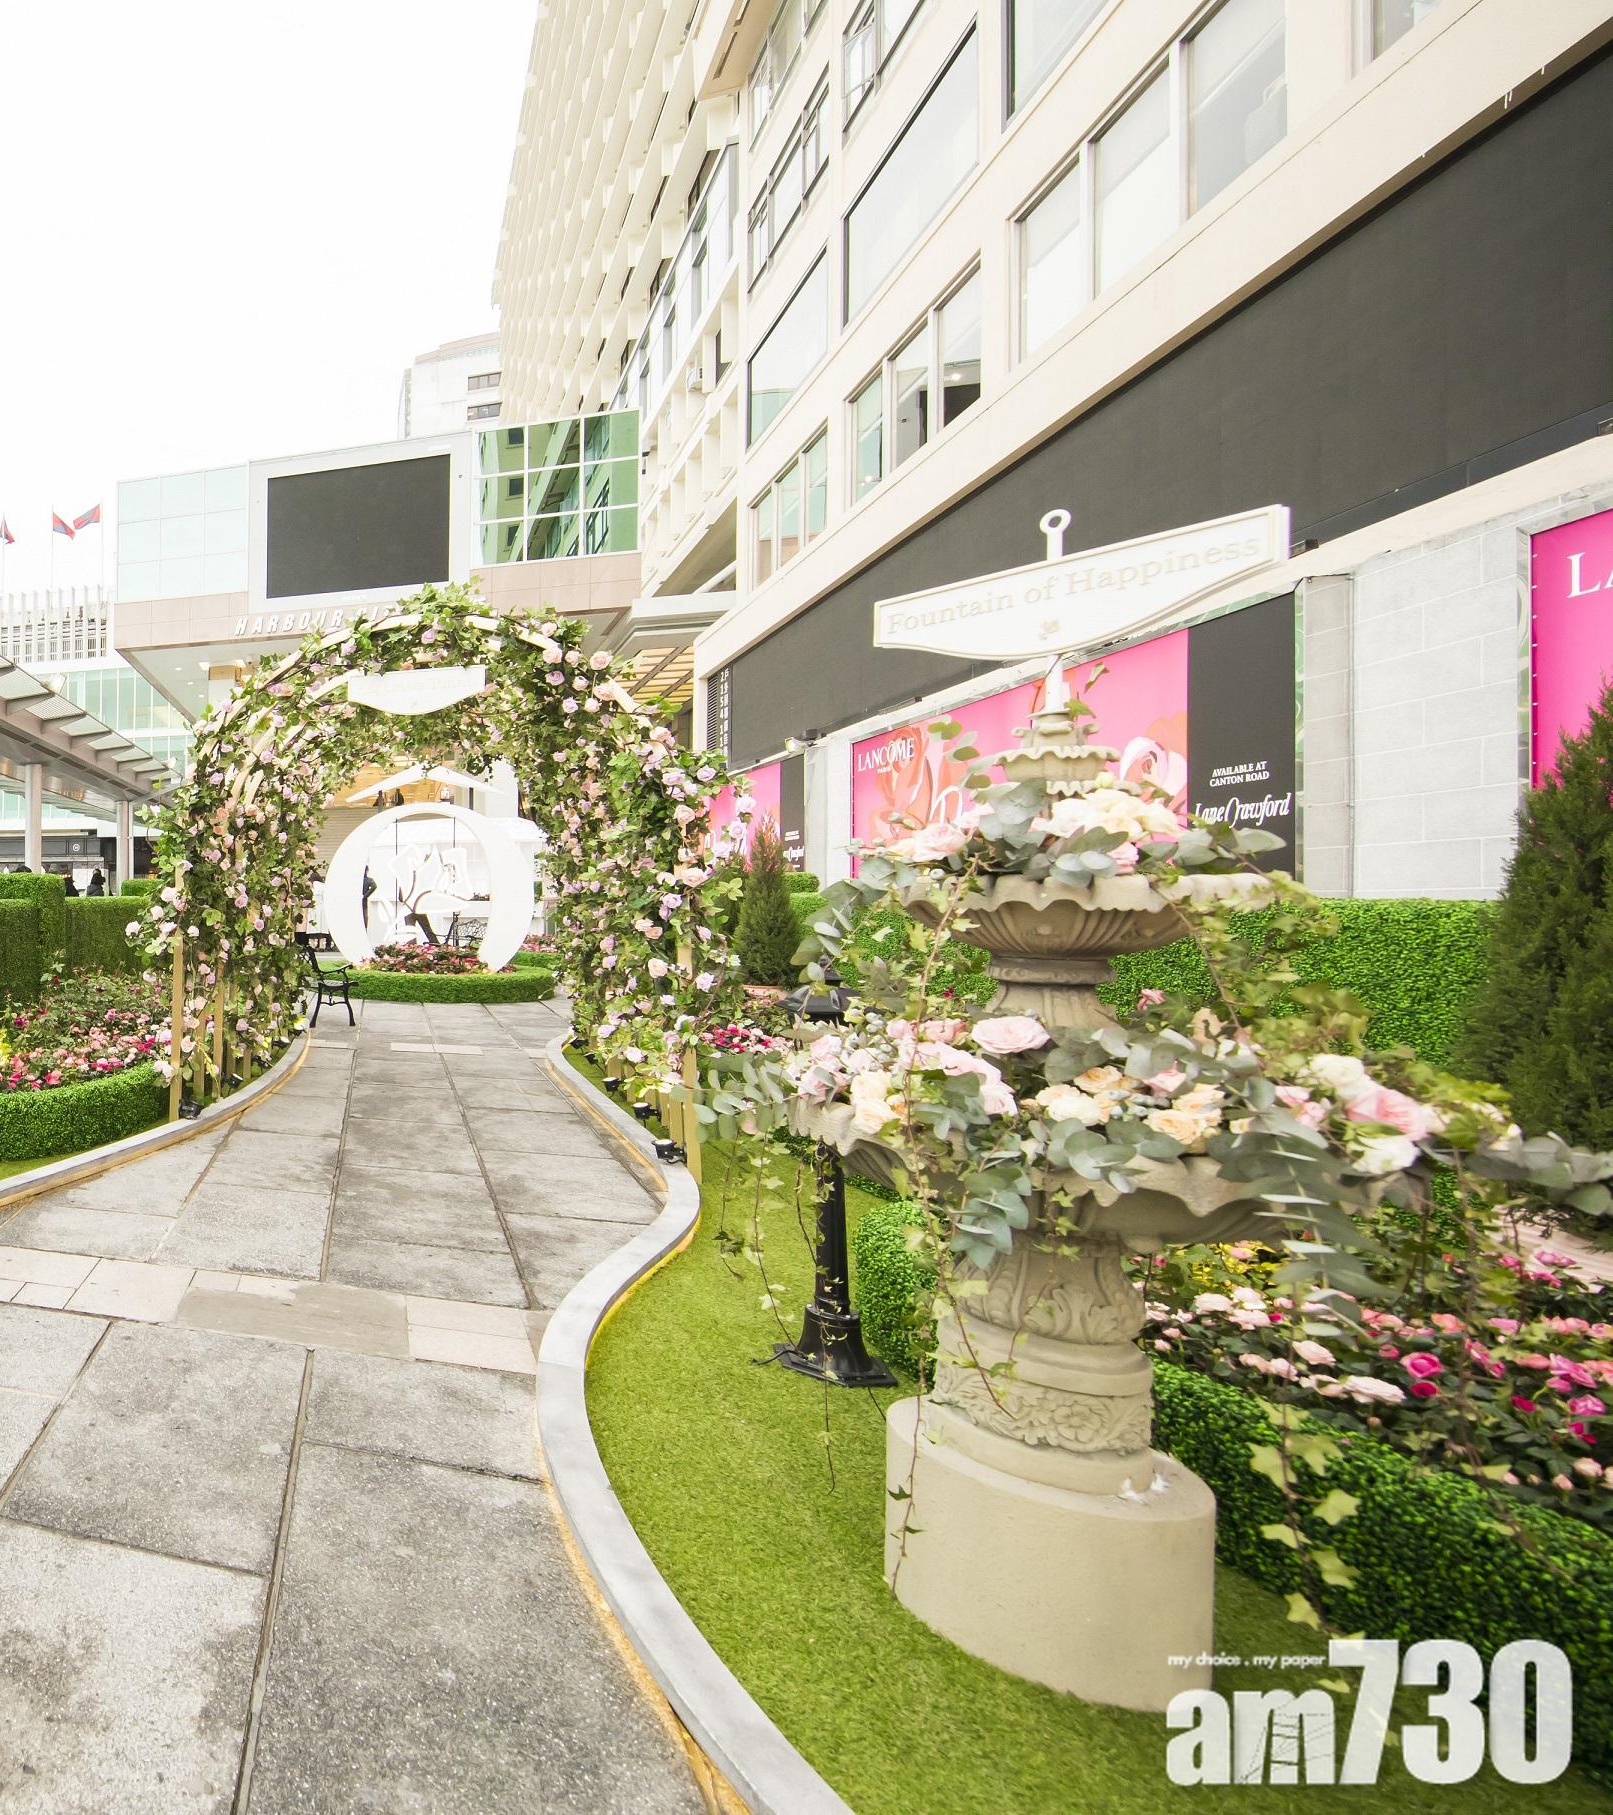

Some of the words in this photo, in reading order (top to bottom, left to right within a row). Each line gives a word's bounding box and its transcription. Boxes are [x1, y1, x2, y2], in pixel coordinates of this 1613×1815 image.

[886, 591, 1016, 634] Fountain
[1024, 575, 1061, 604] of
[1066, 535, 1262, 596] Happiness
[858, 737, 915, 772] LANCÔME
[1212, 763, 1254, 778] AVAILABLE
[1255, 761, 1268, 772] AT
[1209, 774, 1245, 788] CANTON
[1245, 771, 1270, 783] ROAD
[1195, 803, 1225, 823] Lane
[1224, 793, 1292, 829] Crawford
